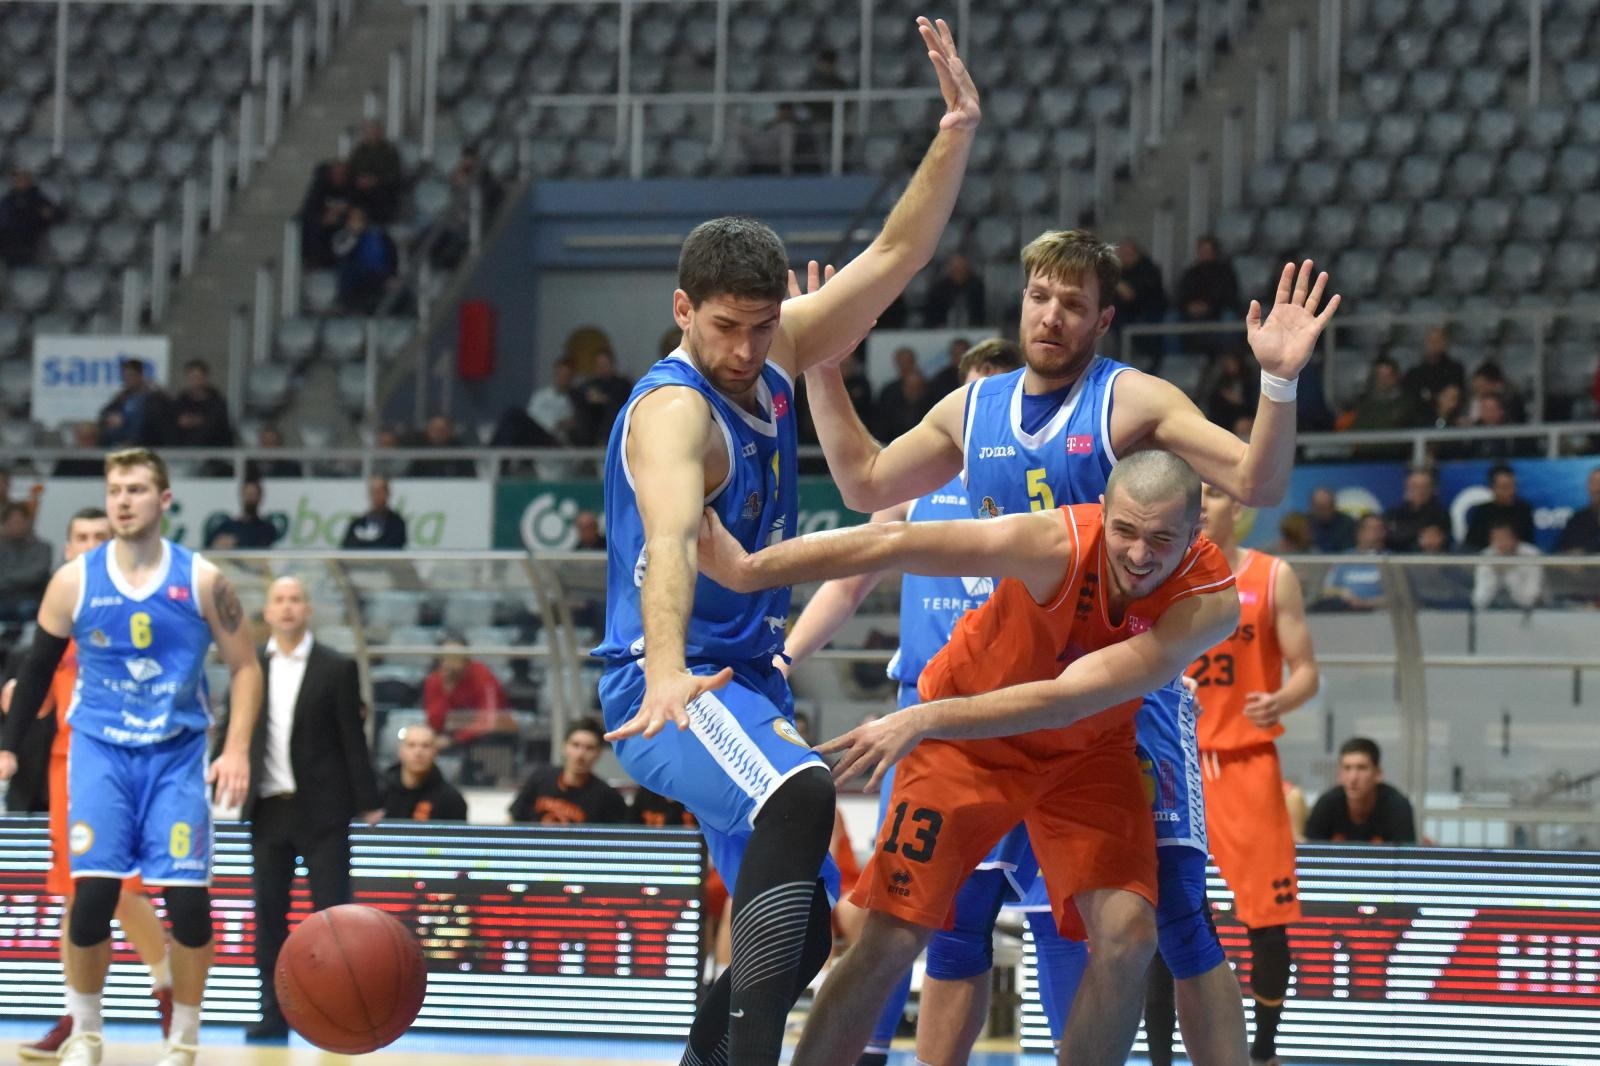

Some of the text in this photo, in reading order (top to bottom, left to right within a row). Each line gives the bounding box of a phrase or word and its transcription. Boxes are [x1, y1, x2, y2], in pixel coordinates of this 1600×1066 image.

[1026, 467, 1055, 513] 5
[922, 597, 972, 611] TERME
[130, 612, 152, 649] 6
[1192, 654, 1235, 687] 23
[169, 821, 191, 859] 6
[883, 801, 944, 864] 13
